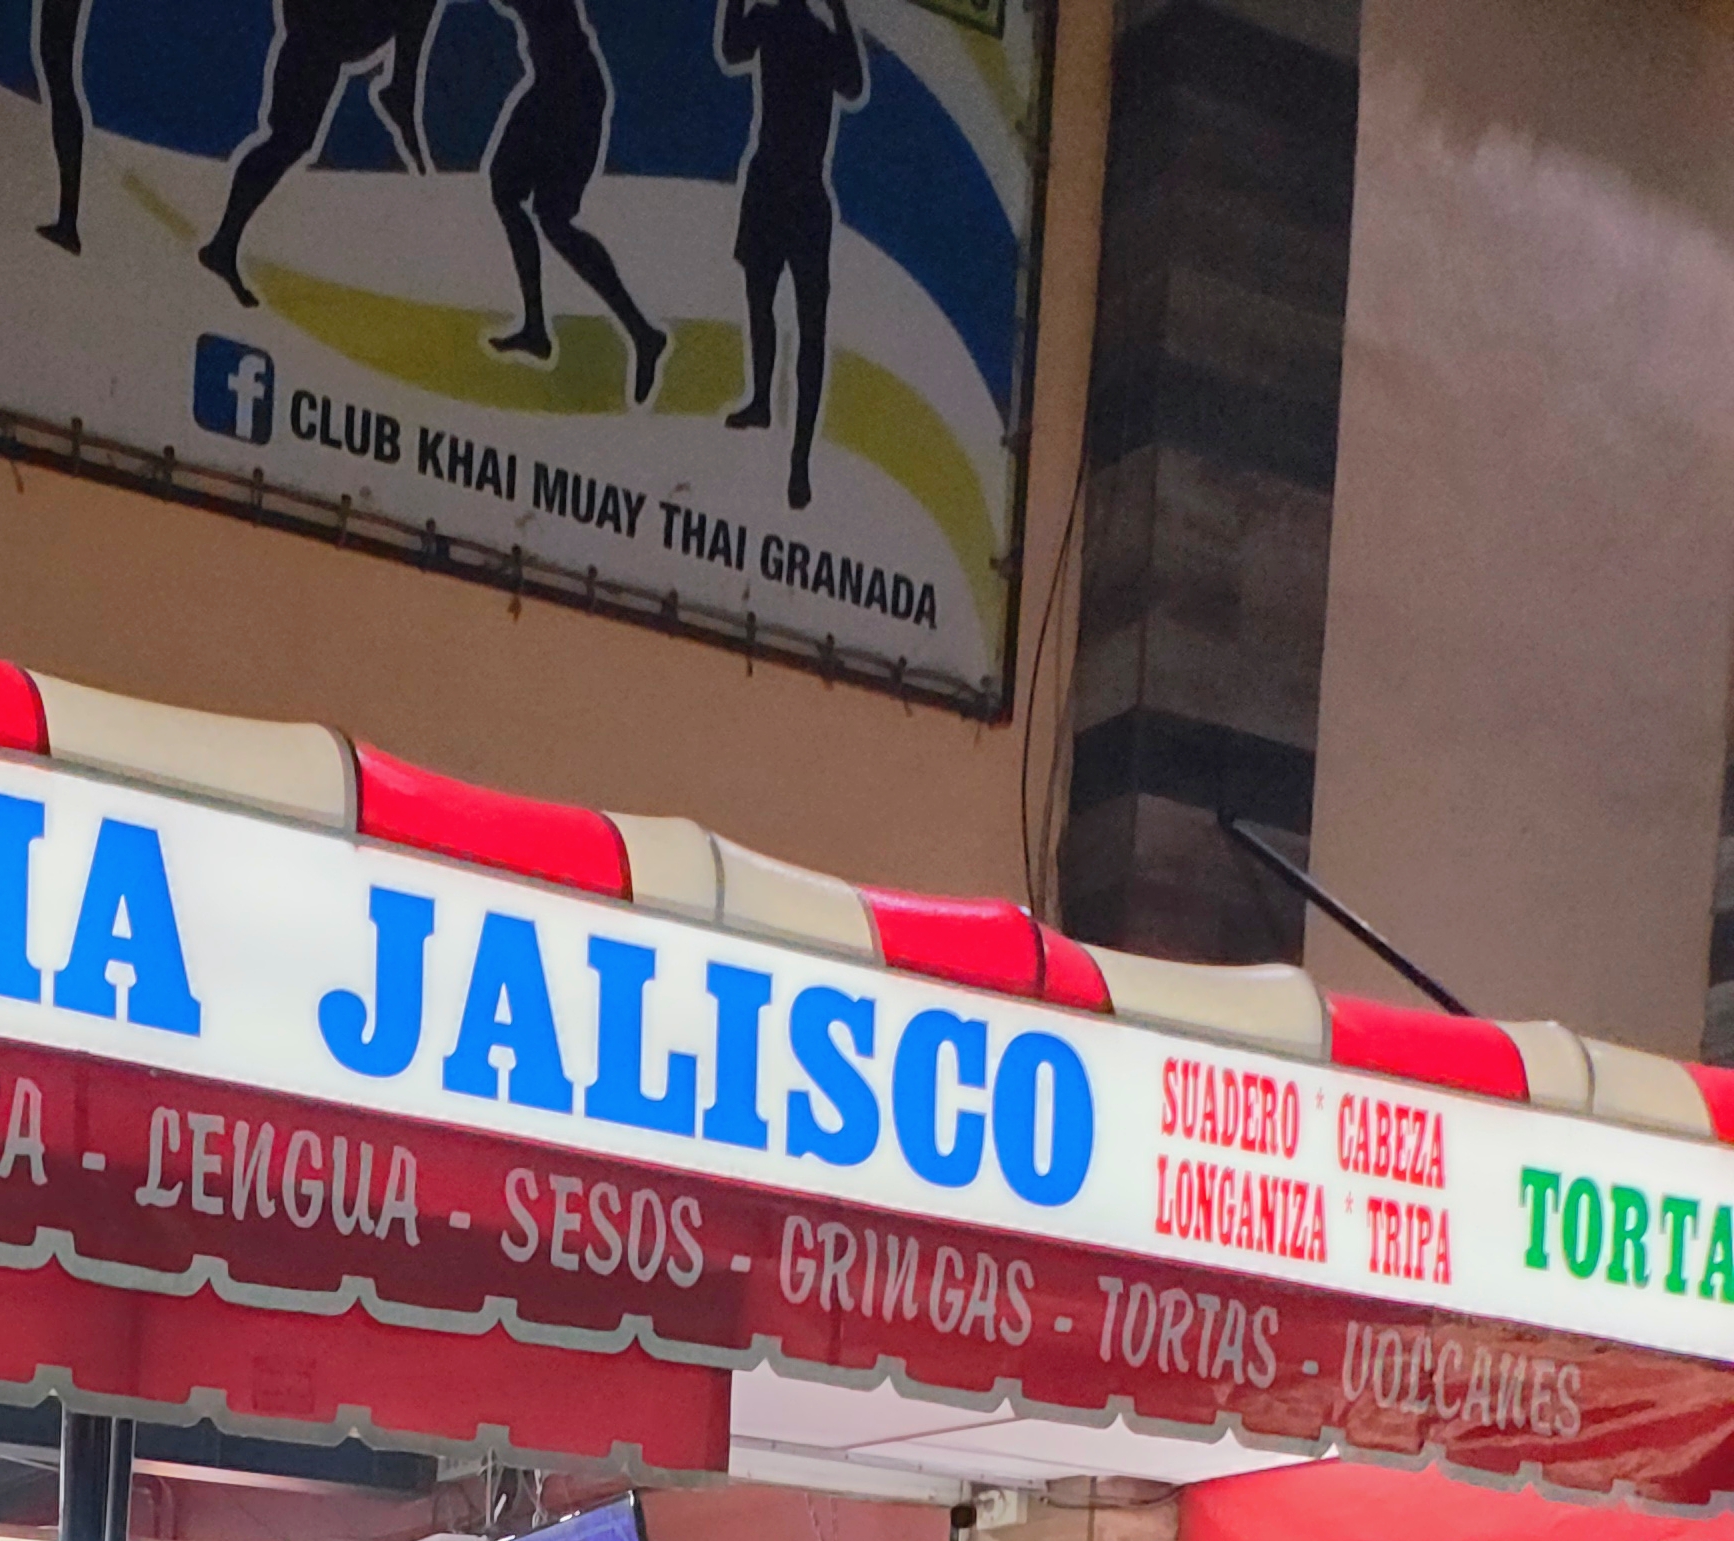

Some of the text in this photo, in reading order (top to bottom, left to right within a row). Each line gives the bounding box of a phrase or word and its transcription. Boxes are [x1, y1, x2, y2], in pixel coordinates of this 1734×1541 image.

[290, 388, 938, 630] CLUB KHAI MUAY THAI GRANADA
[318, 885, 1096, 1207] JALISCO
[1160, 1055, 1446, 1189] SUADERO CABEZA
[134, 1107, 421, 1246] LENGUA
[500, 1167, 704, 1289] SESOS
[780, 1215, 1035, 1346] GRINGAS
[1098, 1275, 1279, 1390] TORTAS
[1154, 1153, 1452, 1285] LONGANIZA TRIPA
